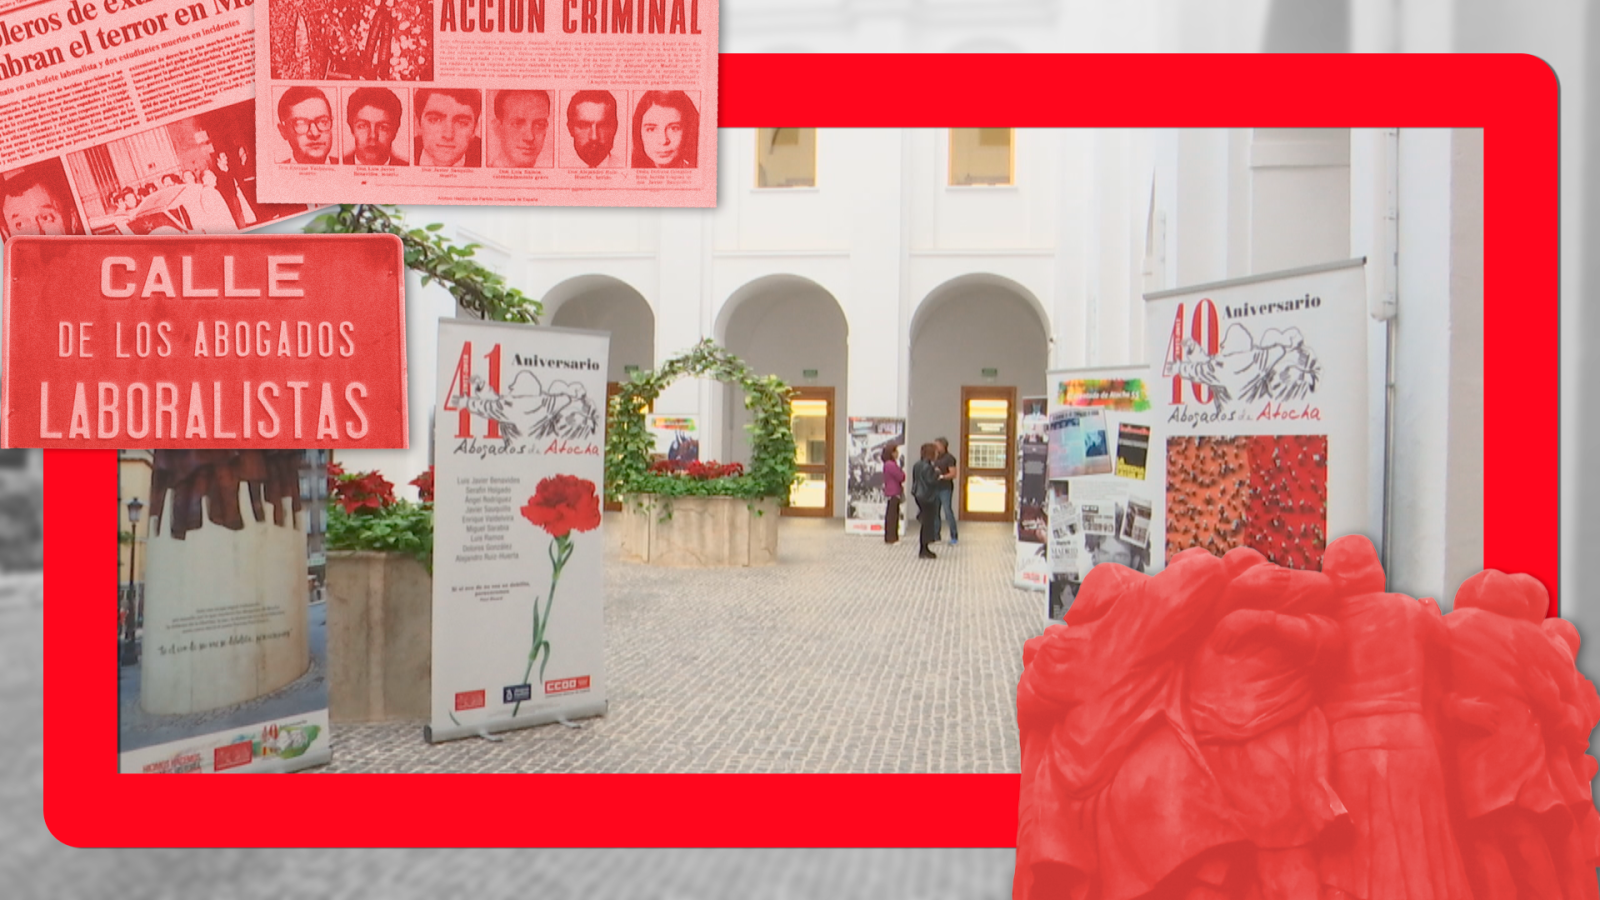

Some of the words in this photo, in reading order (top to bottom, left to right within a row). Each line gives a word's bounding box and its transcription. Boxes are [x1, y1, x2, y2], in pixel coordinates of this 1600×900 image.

[0, 12, 62, 46] leros
[67, 0, 98, 26] de
[70, 30, 95, 58] el
[96, 13, 169, 50] terror
[175, 2, 208, 26] en
[562, 0, 702, 35] CRIMINAL
[36, 76, 59, 86] bufete
[60, 64, 97, 79] laboralista
[105, 54, 117, 66] dos
[119, 44, 160, 62] estudiantes
[161, 35, 190, 49] muertos
[192, 32, 201, 40] en
[202, 20, 240, 36] incidentes
[101, 255, 304, 298] CALLE
[1224, 294, 1321, 319] Aniversario
[58, 322, 94, 358] DE
[116, 322, 172, 358] LOS
[194, 320, 355, 358] ABOGADOS
[444, 341, 504, 439] 41
[512, 353, 600, 371] Aniversario
[40, 381, 369, 440] LABORALISTAS
[1168, 404, 1236, 428] Abogados
[1256, 402, 1321, 421] Atocha
[454, 438, 526, 460] Abogados
[544, 439, 600, 456] Atocha
[547, 680, 576, 691] CCOO
